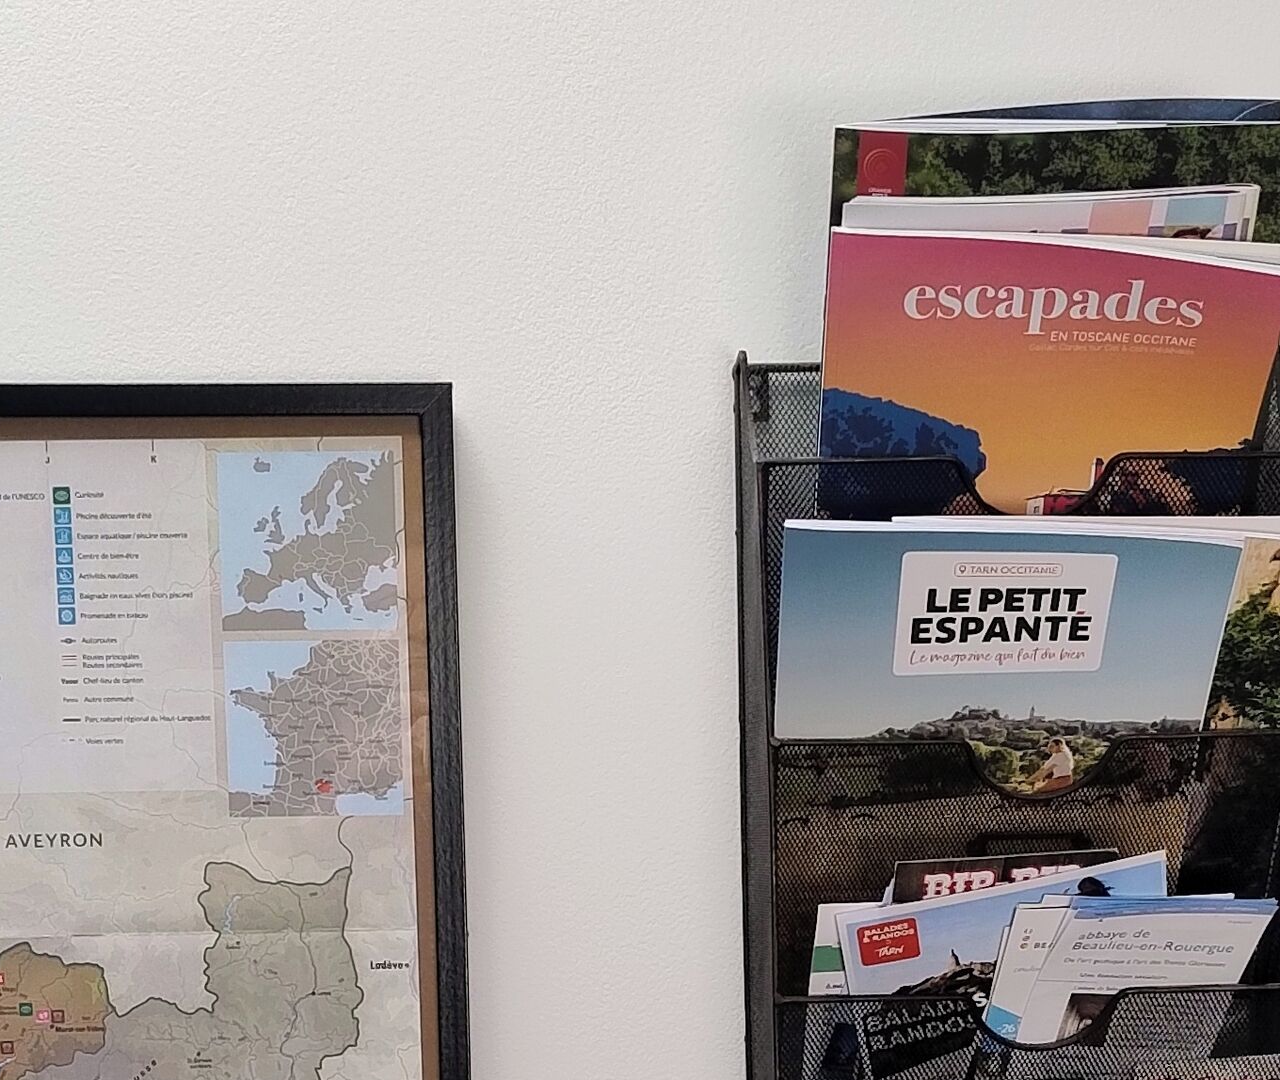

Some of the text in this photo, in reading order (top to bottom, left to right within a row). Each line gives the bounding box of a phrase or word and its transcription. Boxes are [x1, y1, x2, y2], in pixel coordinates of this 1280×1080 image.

[903, 279, 1204, 335] escapades
[1050, 330, 1198, 347] EN TOSCANE OCCITANE
[970, 566, 1058, 575] TARN OCCITANIE
[926, 587, 1086, 613] LE PETIT
[910, 611, 1092, 645] ESPANTÉ
[909, 648, 1085, 667] Le magazine qui fait du bien
[5, 832, 103, 848] AVEYRON
[863, 922, 909, 937] BALADES
[870, 928, 915, 942] RANDOS
[1078, 929, 1151, 942] abbaye de
[875, 944, 905, 958] TARN
[1072, 941, 1235, 955] Beaulieu-en-Rouergue
